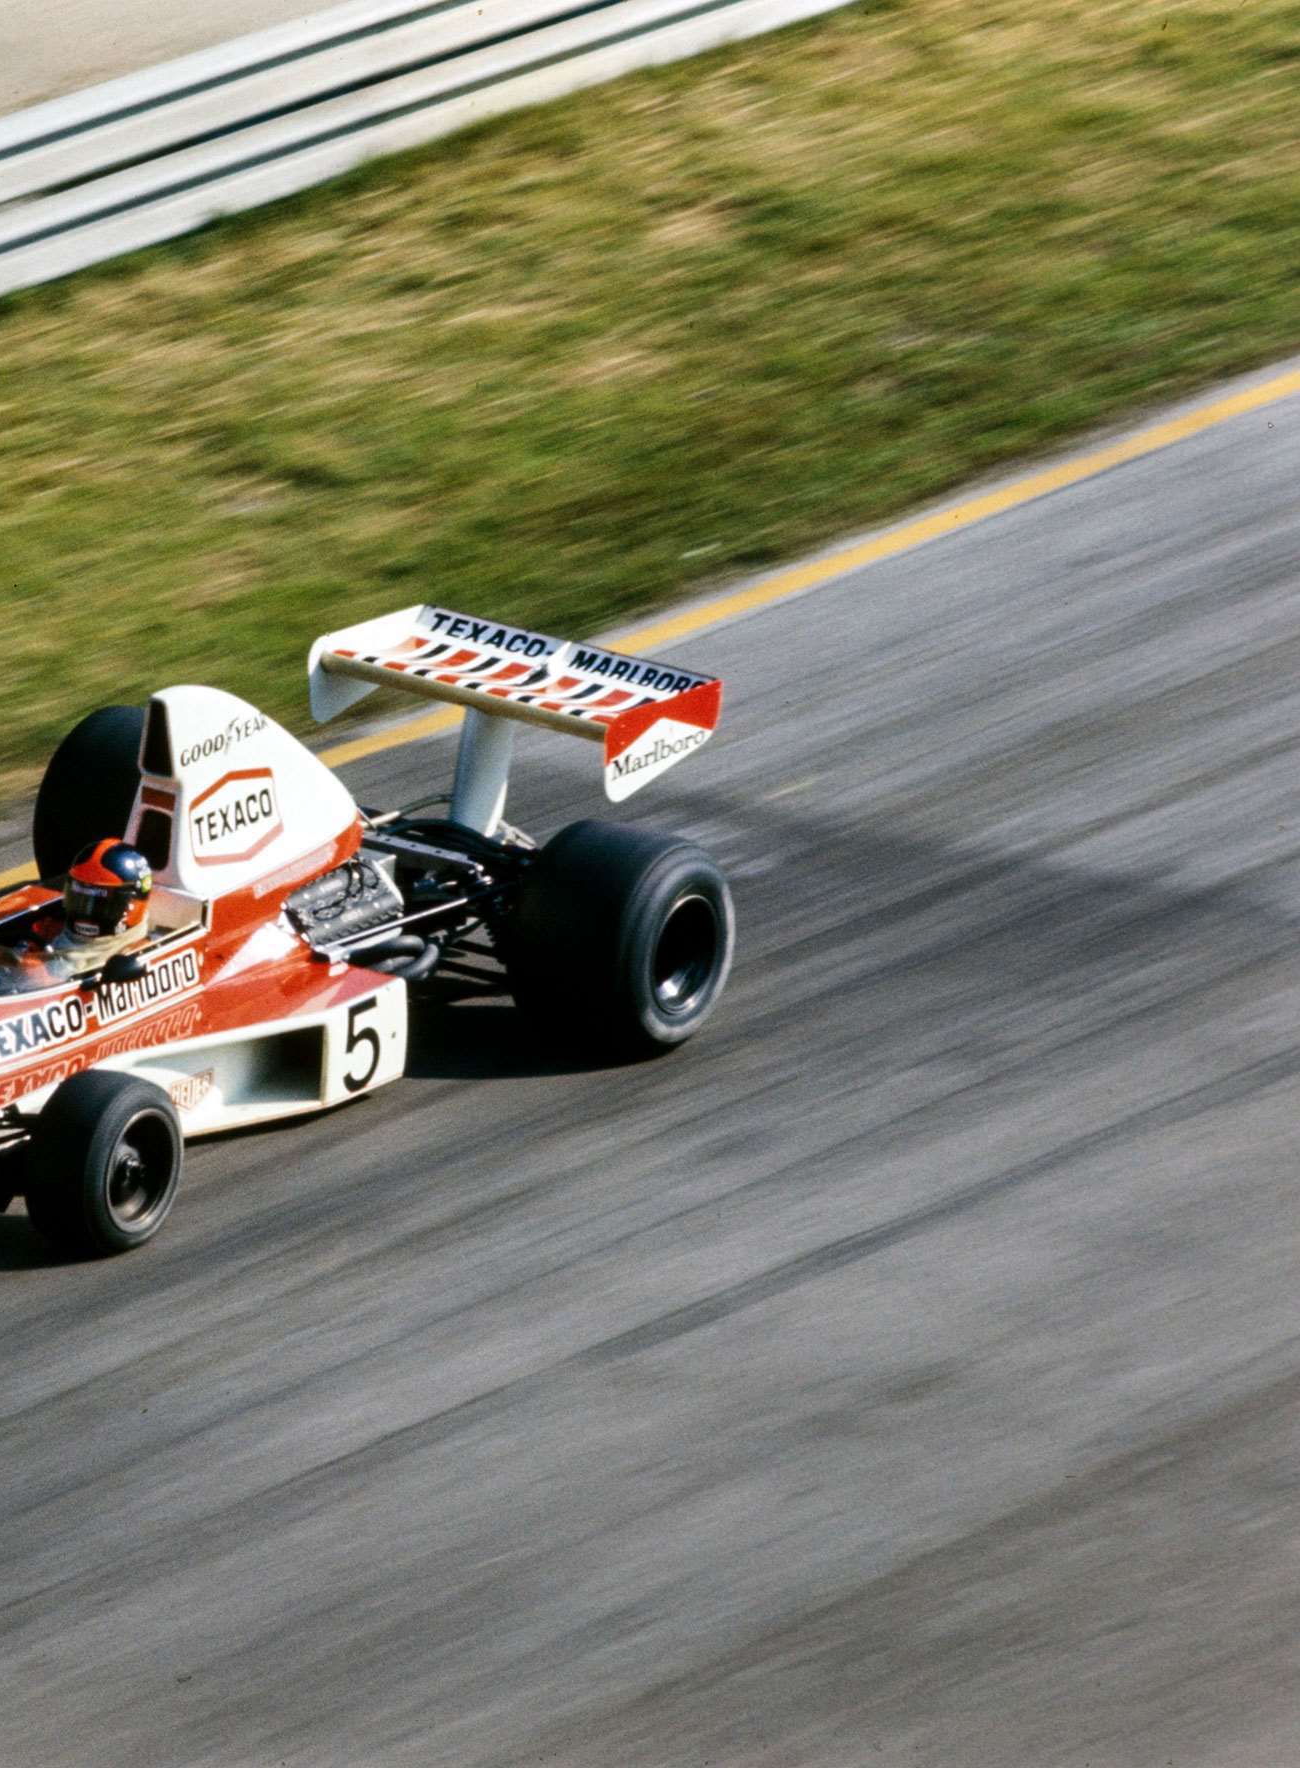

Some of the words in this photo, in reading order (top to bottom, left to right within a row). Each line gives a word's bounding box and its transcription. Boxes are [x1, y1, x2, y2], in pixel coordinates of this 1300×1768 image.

[611, 731, 705, 780] Marlboro
[194, 788, 272, 846] TEXACO
[343, 995, 381, 1092] 5
